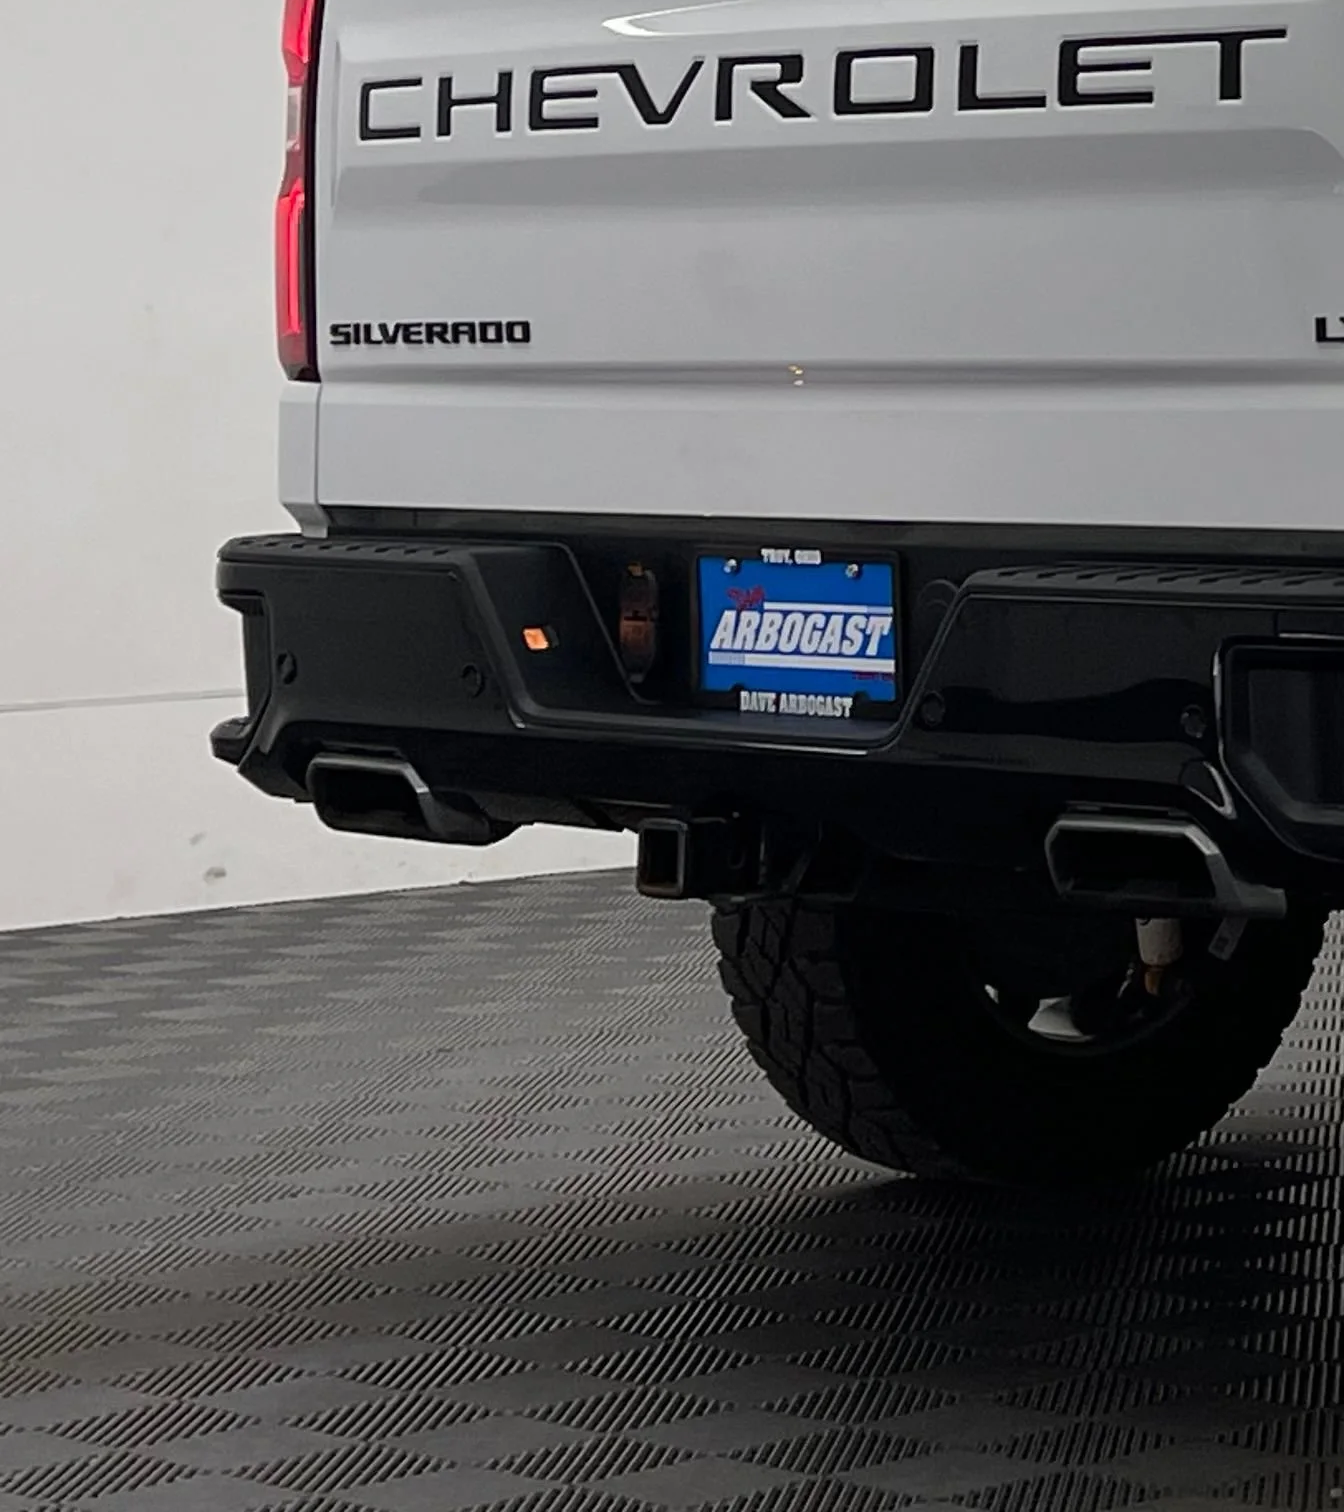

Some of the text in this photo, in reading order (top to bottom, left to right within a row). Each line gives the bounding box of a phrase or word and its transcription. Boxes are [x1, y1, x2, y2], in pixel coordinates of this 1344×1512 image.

[357, 28, 1287, 143] CHEVROLET
[329, 318, 532, 346] SILVERADO
[710, 609, 893, 656] ARBOGAST
[740, 691, 853, 718] DAVE ARBOGAST
